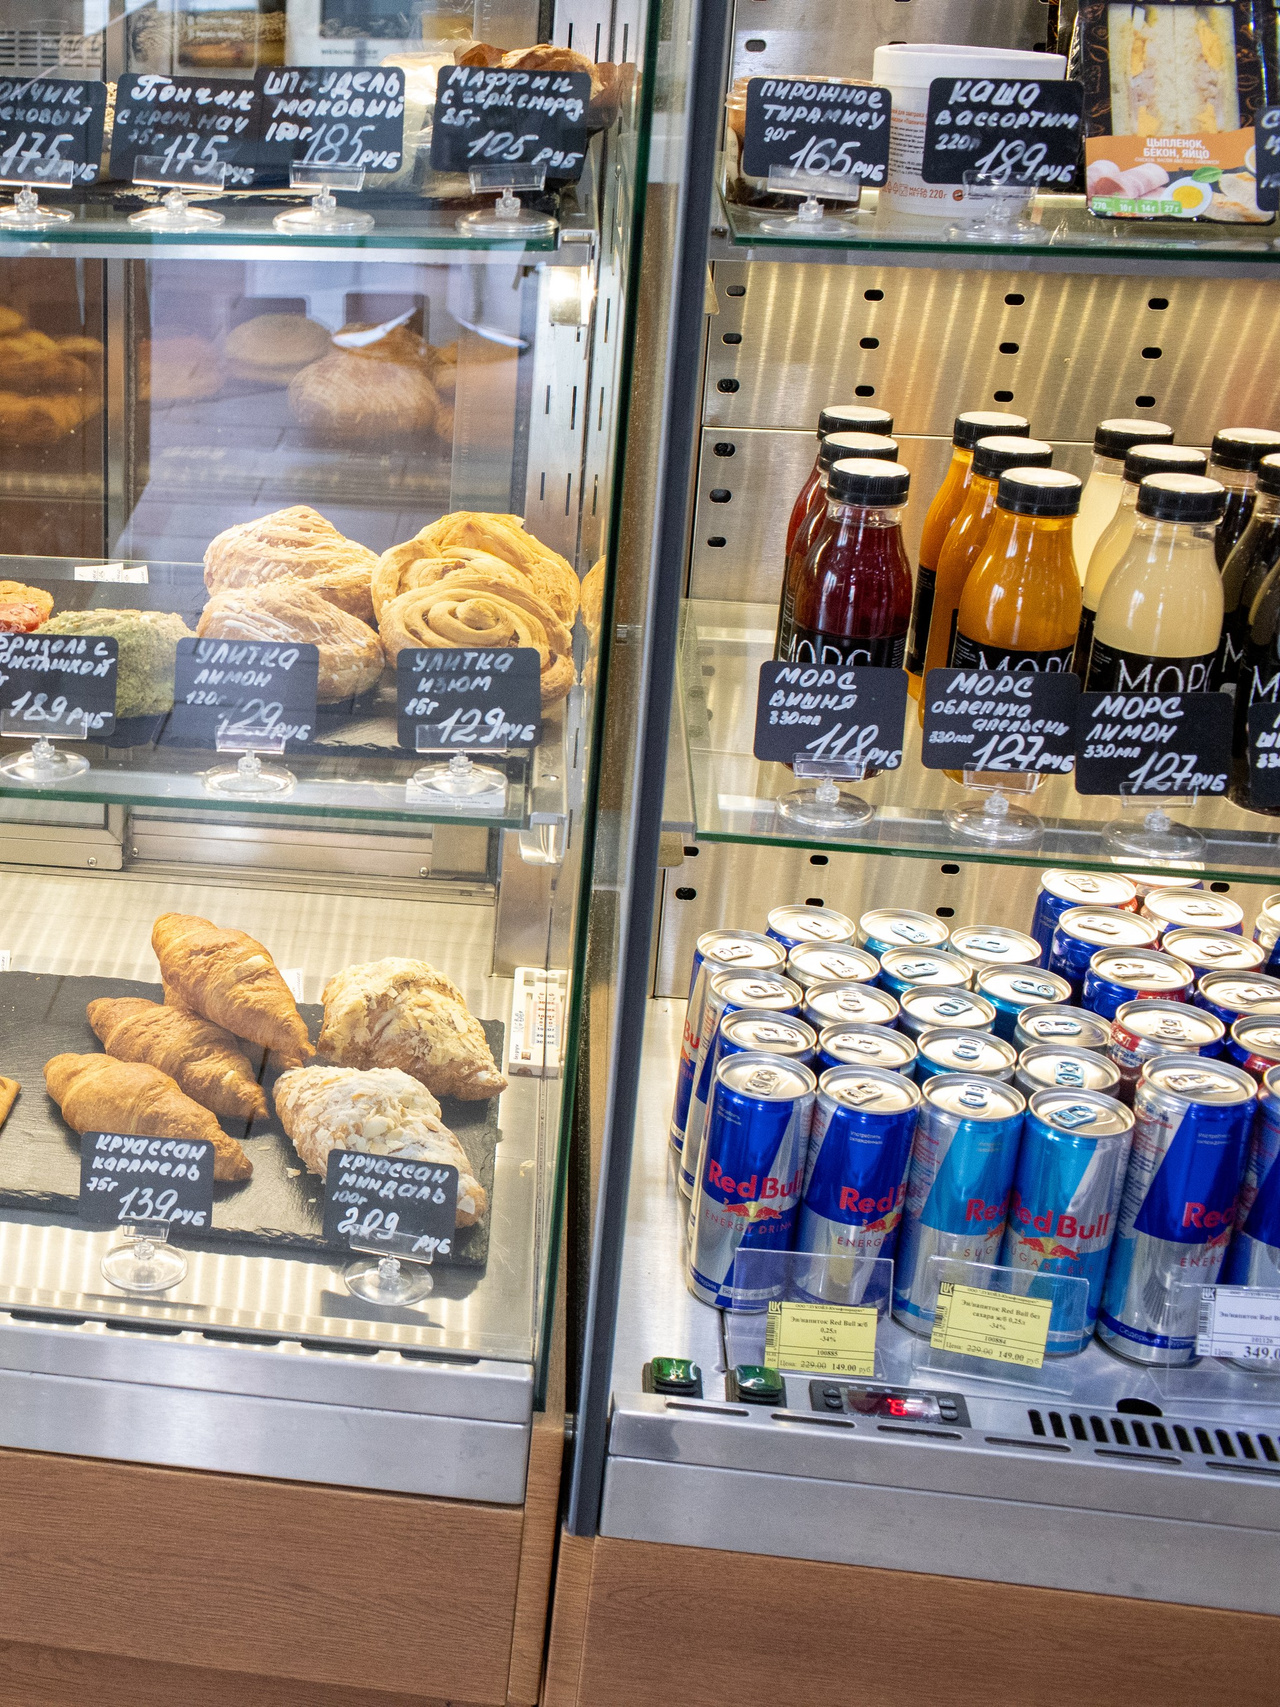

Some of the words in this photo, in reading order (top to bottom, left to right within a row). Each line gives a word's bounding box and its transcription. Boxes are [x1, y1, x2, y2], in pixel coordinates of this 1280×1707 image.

[263, 71, 400, 100] ШТРУДЕЛЬ
[760, 80, 883, 109] ПИРОЖНОЕ
[948, 79, 1041, 106] КАША
[272, 96, 405, 119] МАКОВЫЙ
[762, 103, 886, 131] ТИРАМИСУ
[0, 131, 75, 177] 175
[161, 132, 230, 175] 175
[302, 122, 376, 167] 185
[467, 130, 539, 161] 105
[789, 135, 861, 179] 165
[1143, 148, 1179, 158] БЕКОН,
[1182, 147, 1210, 159] ЯЙЦО
[1146, 138, 1205, 150] ЦЫПЛЕНОК,
[195, 641, 300, 671] УЛИТКА
[412, 651, 515, 673] УЛИТКА
[194, 669, 272, 688] ЛИМОН
[417, 675, 493, 694] ИЗЮМ
[774, 667, 857, 690] МОРС
[946, 672, 1035, 698] МОРС
[10, 690, 68, 722] 189
[768, 689, 858, 711] ВИШНЯ
[930, 699, 1032, 718] ОБЛЕПИХА
[1091, 695, 1184, 721] МОРС
[437, 706, 506, 743] 129
[1085, 722, 1178, 744] ЛИМОН
[806, 723, 879, 762] 118
[972, 733, 1045, 772] 127
[1128, 751, 1198, 794] 127
[95, 1134, 207, 1161] КРУАССАН
[92, 1156, 201, 1182] КАРАМЕЛЬ
[339, 1153, 450, 1184] КРУАССАН
[708, 1159, 758, 1199] Red
[339, 1172, 447, 1205] МИНДАЛЬ
[839, 1185, 894, 1214] Red
[118, 1187, 178, 1221] 139
[1055, 1212, 1111, 1240] Bull
[832, 1363, 857, 1372] 149.00
[998, 1350, 1025, 1362] 149.00
